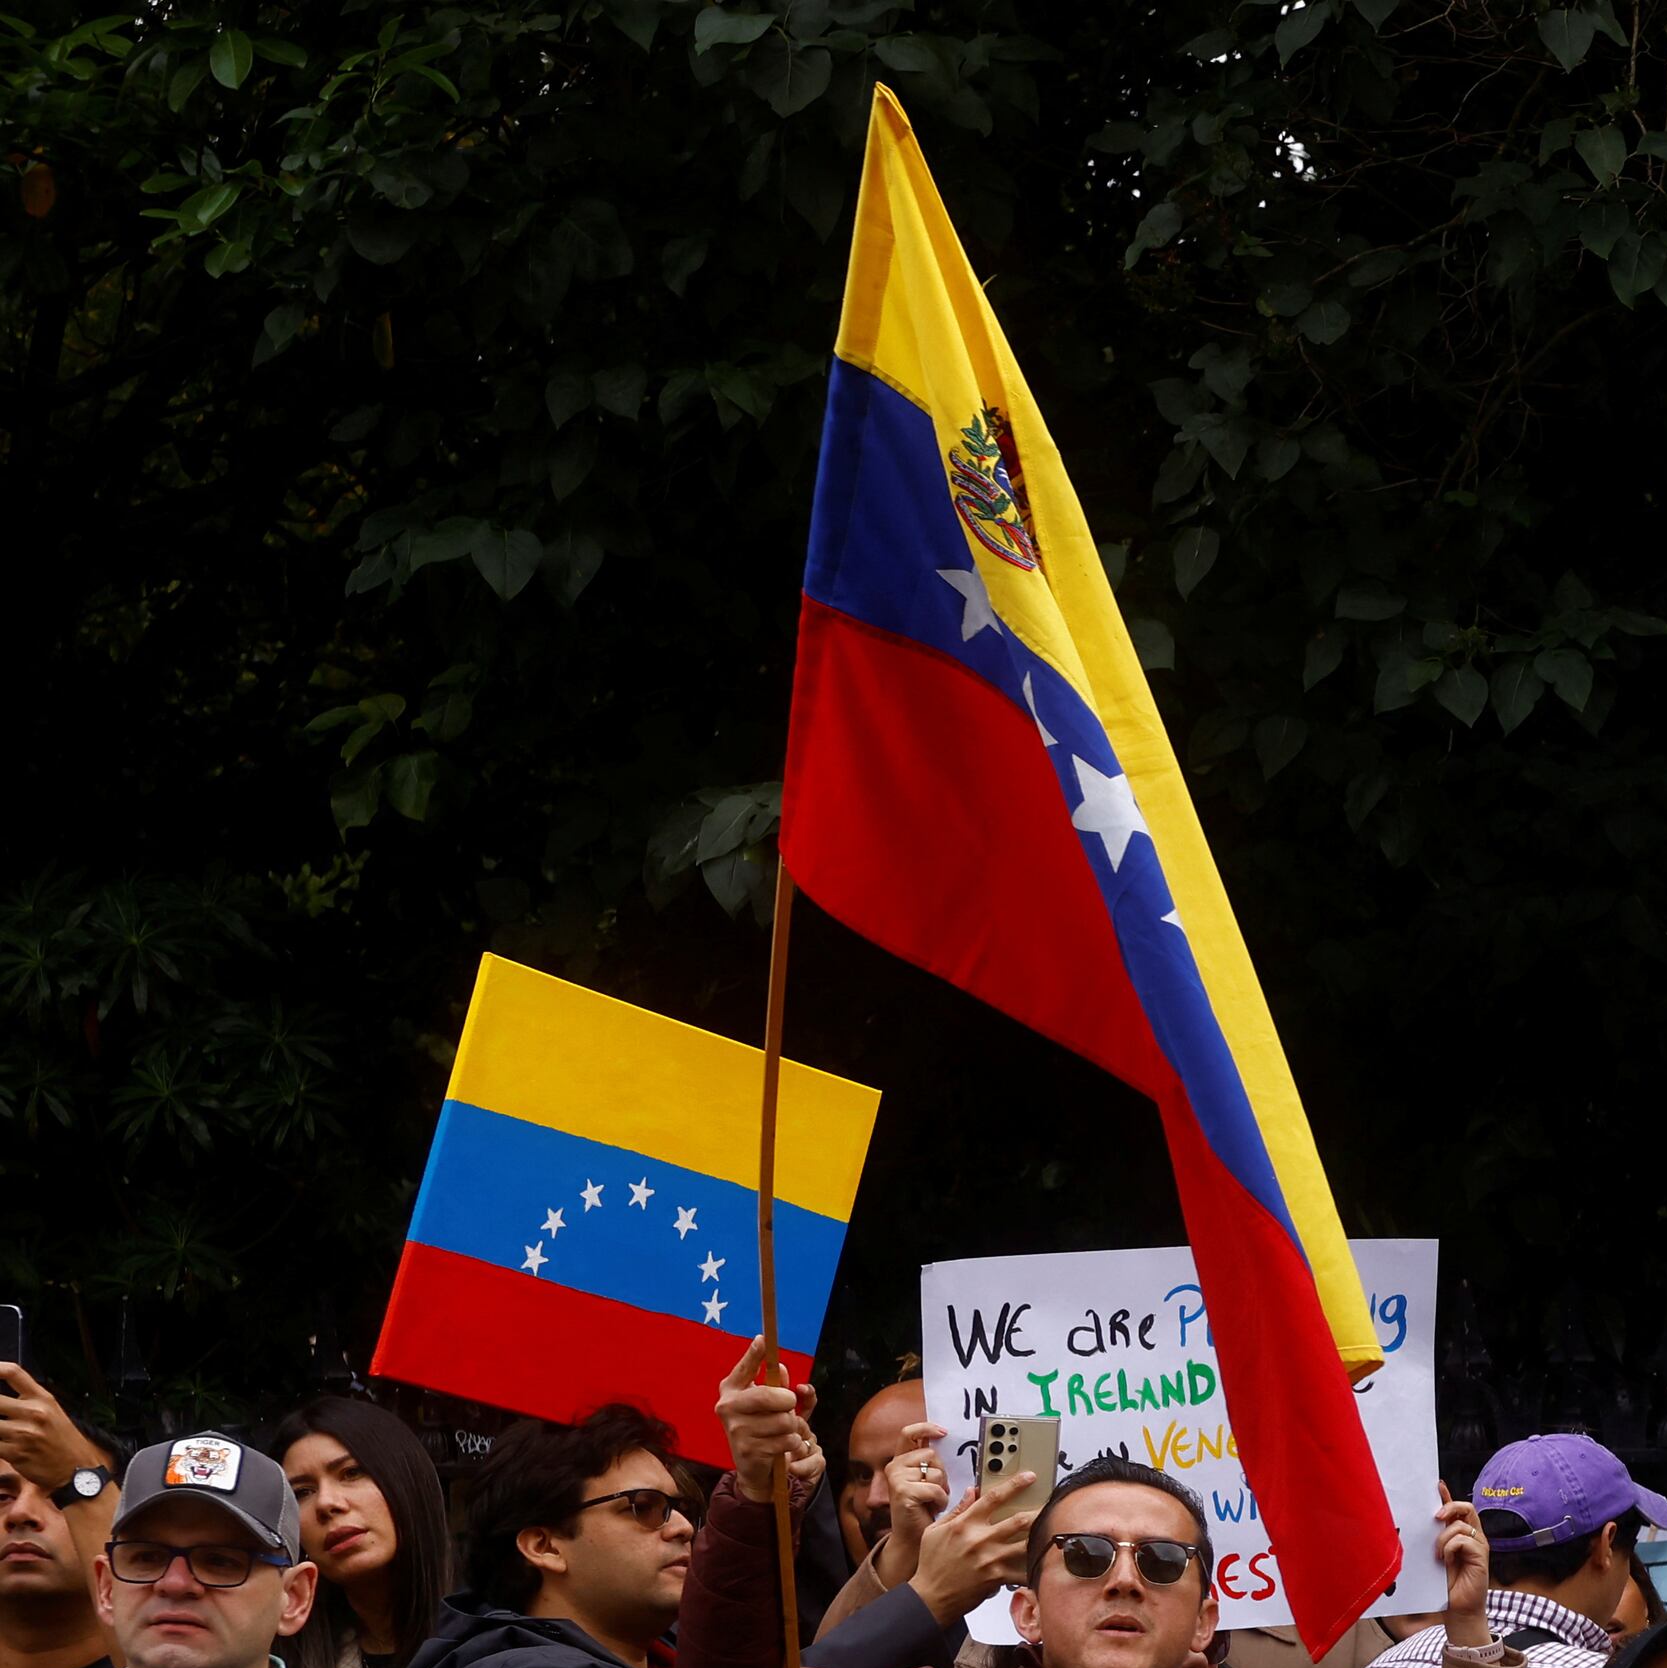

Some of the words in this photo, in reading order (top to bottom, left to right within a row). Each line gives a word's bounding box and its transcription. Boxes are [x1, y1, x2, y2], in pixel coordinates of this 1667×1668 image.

[947, 1303, 1036, 1368] WE
[965, 1386, 997, 1419] IN
[1028, 1360, 1217, 1417] IRELAND
[196, 1439, 220, 1447] TIGER
